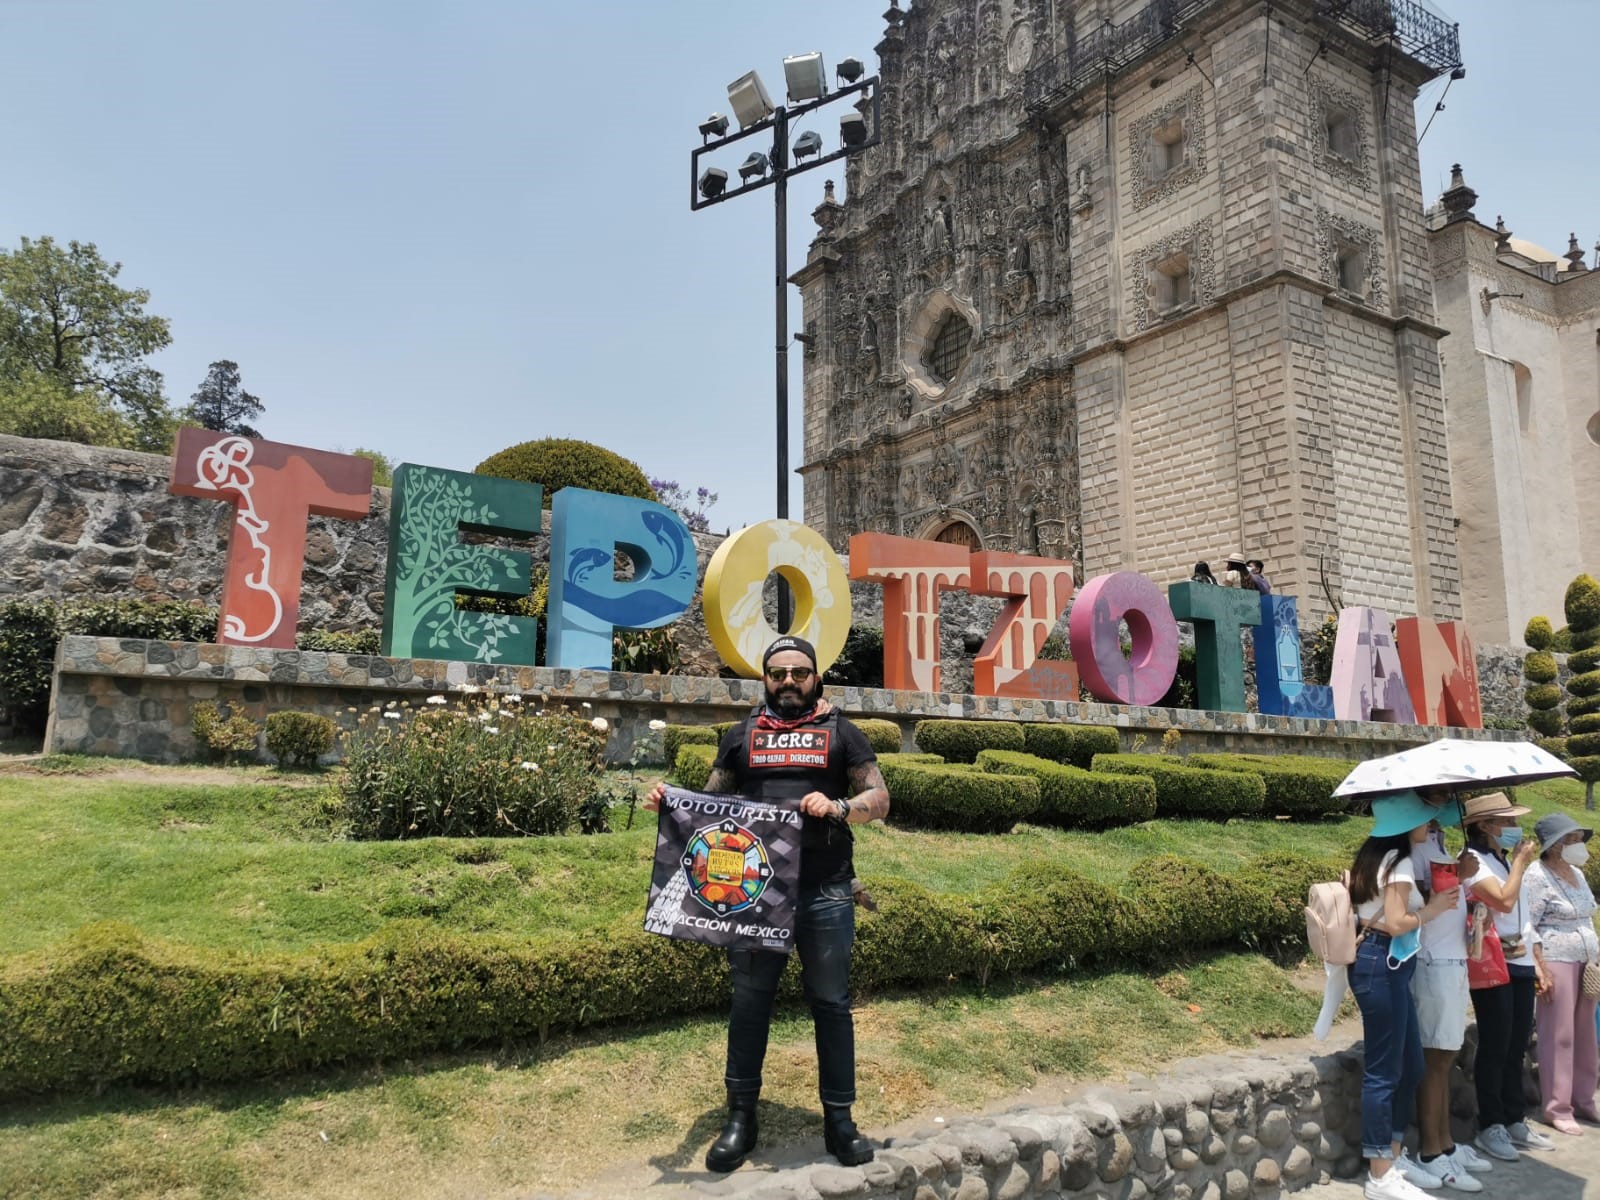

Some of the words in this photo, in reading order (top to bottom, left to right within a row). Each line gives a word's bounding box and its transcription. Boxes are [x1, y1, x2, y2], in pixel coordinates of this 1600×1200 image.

[168, 427, 1482, 729] TEPOTZOTLAN
[765, 732, 814, 749] LCRC
[790, 753, 825, 764] DIRECTOR
[665, 795, 800, 824] MOTOTURISTA
[723, 823, 734, 832] N
[760, 868, 769, 877] E
[717, 903, 726, 912] S
